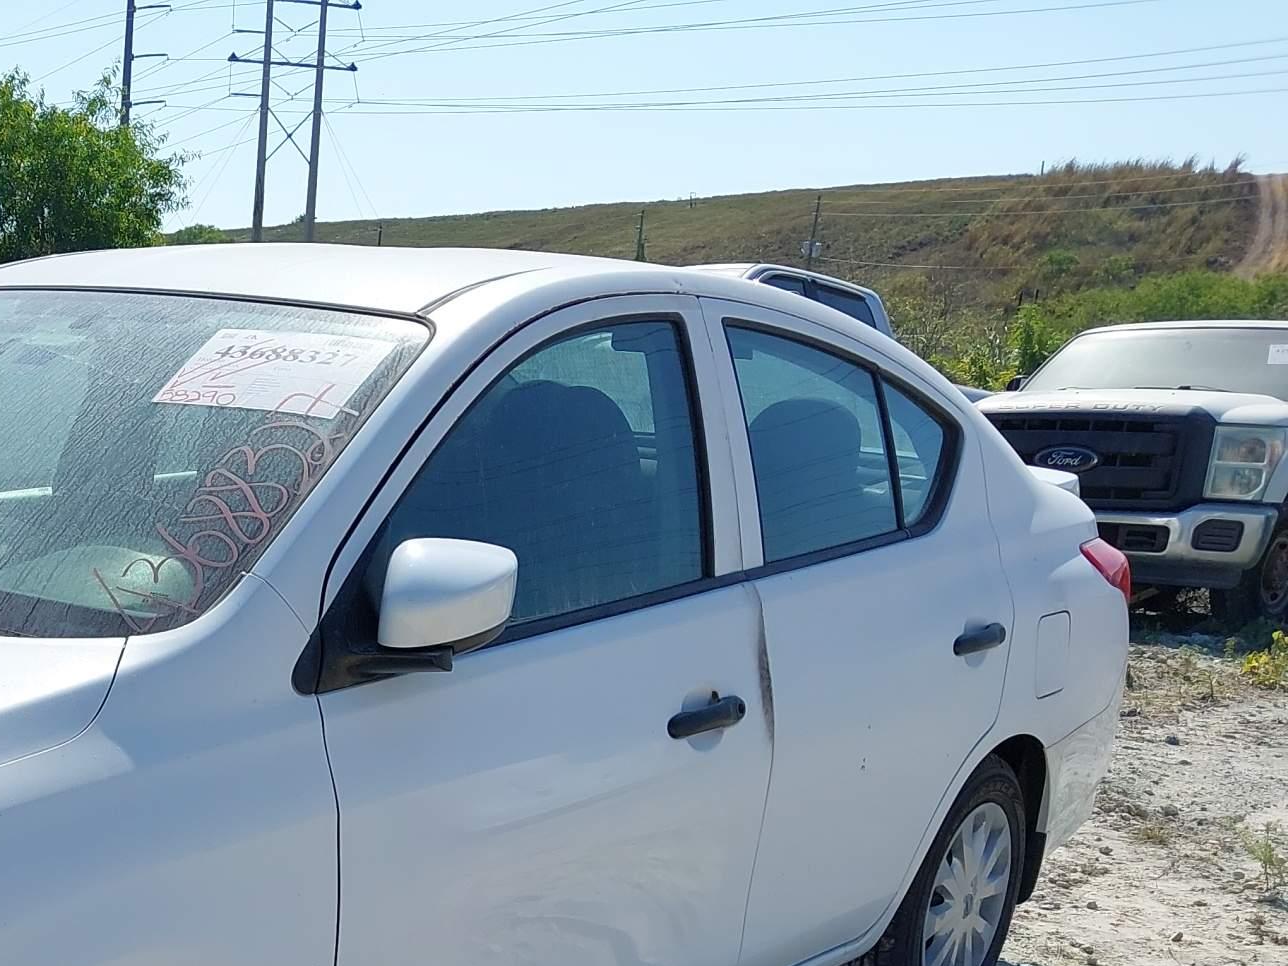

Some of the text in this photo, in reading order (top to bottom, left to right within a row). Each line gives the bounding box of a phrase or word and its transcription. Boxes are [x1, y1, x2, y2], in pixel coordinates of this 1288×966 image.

[215, 344, 360, 368] 43688327
[998, 402, 1167, 413] SUPER DUTY
[1047, 451, 1082, 466] Ford
[93, 384, 361, 633] 43688327
